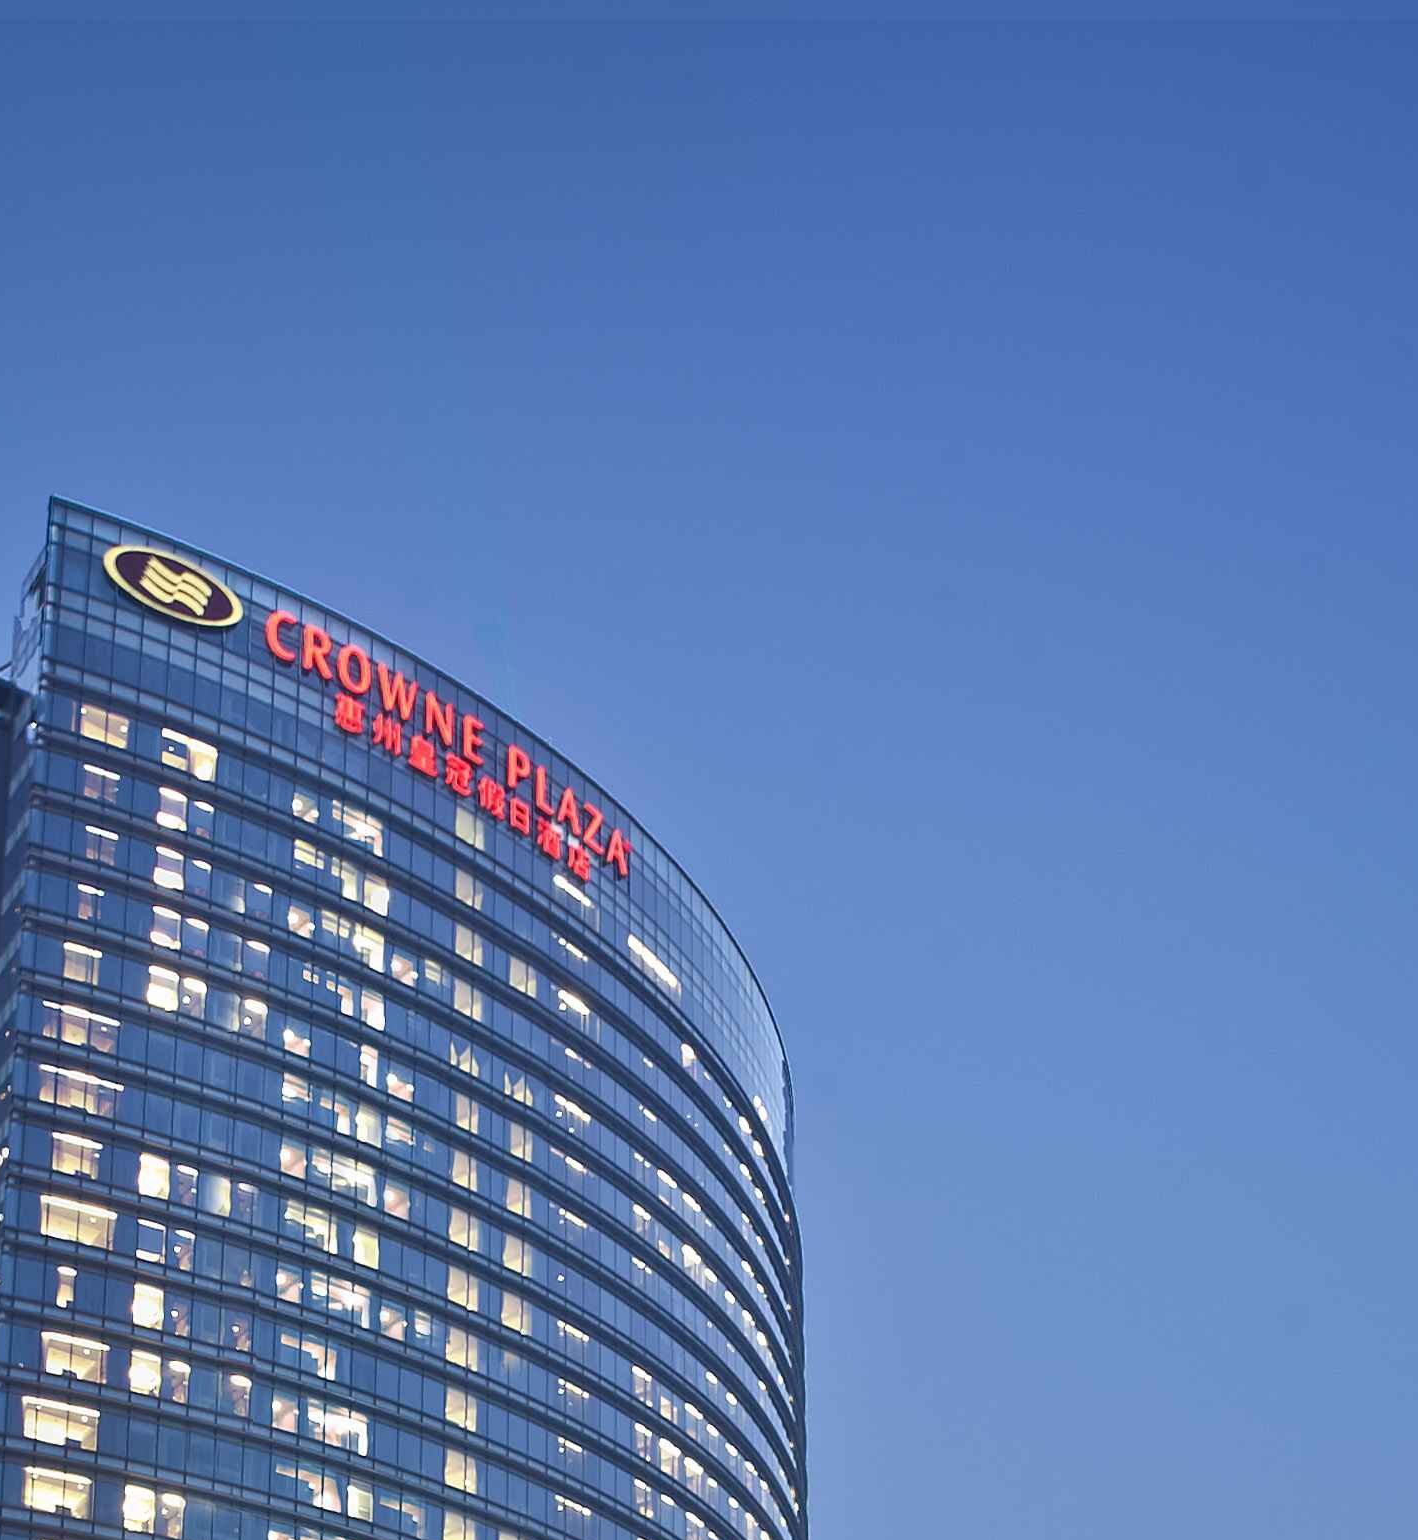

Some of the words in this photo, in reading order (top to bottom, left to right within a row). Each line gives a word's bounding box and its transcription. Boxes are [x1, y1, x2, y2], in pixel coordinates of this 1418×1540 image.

[264, 610, 485, 766] CROWNE
[506, 743, 630, 878] PLAZA
[334, 691, 591, 882] 惠州皇冠假日酒店
